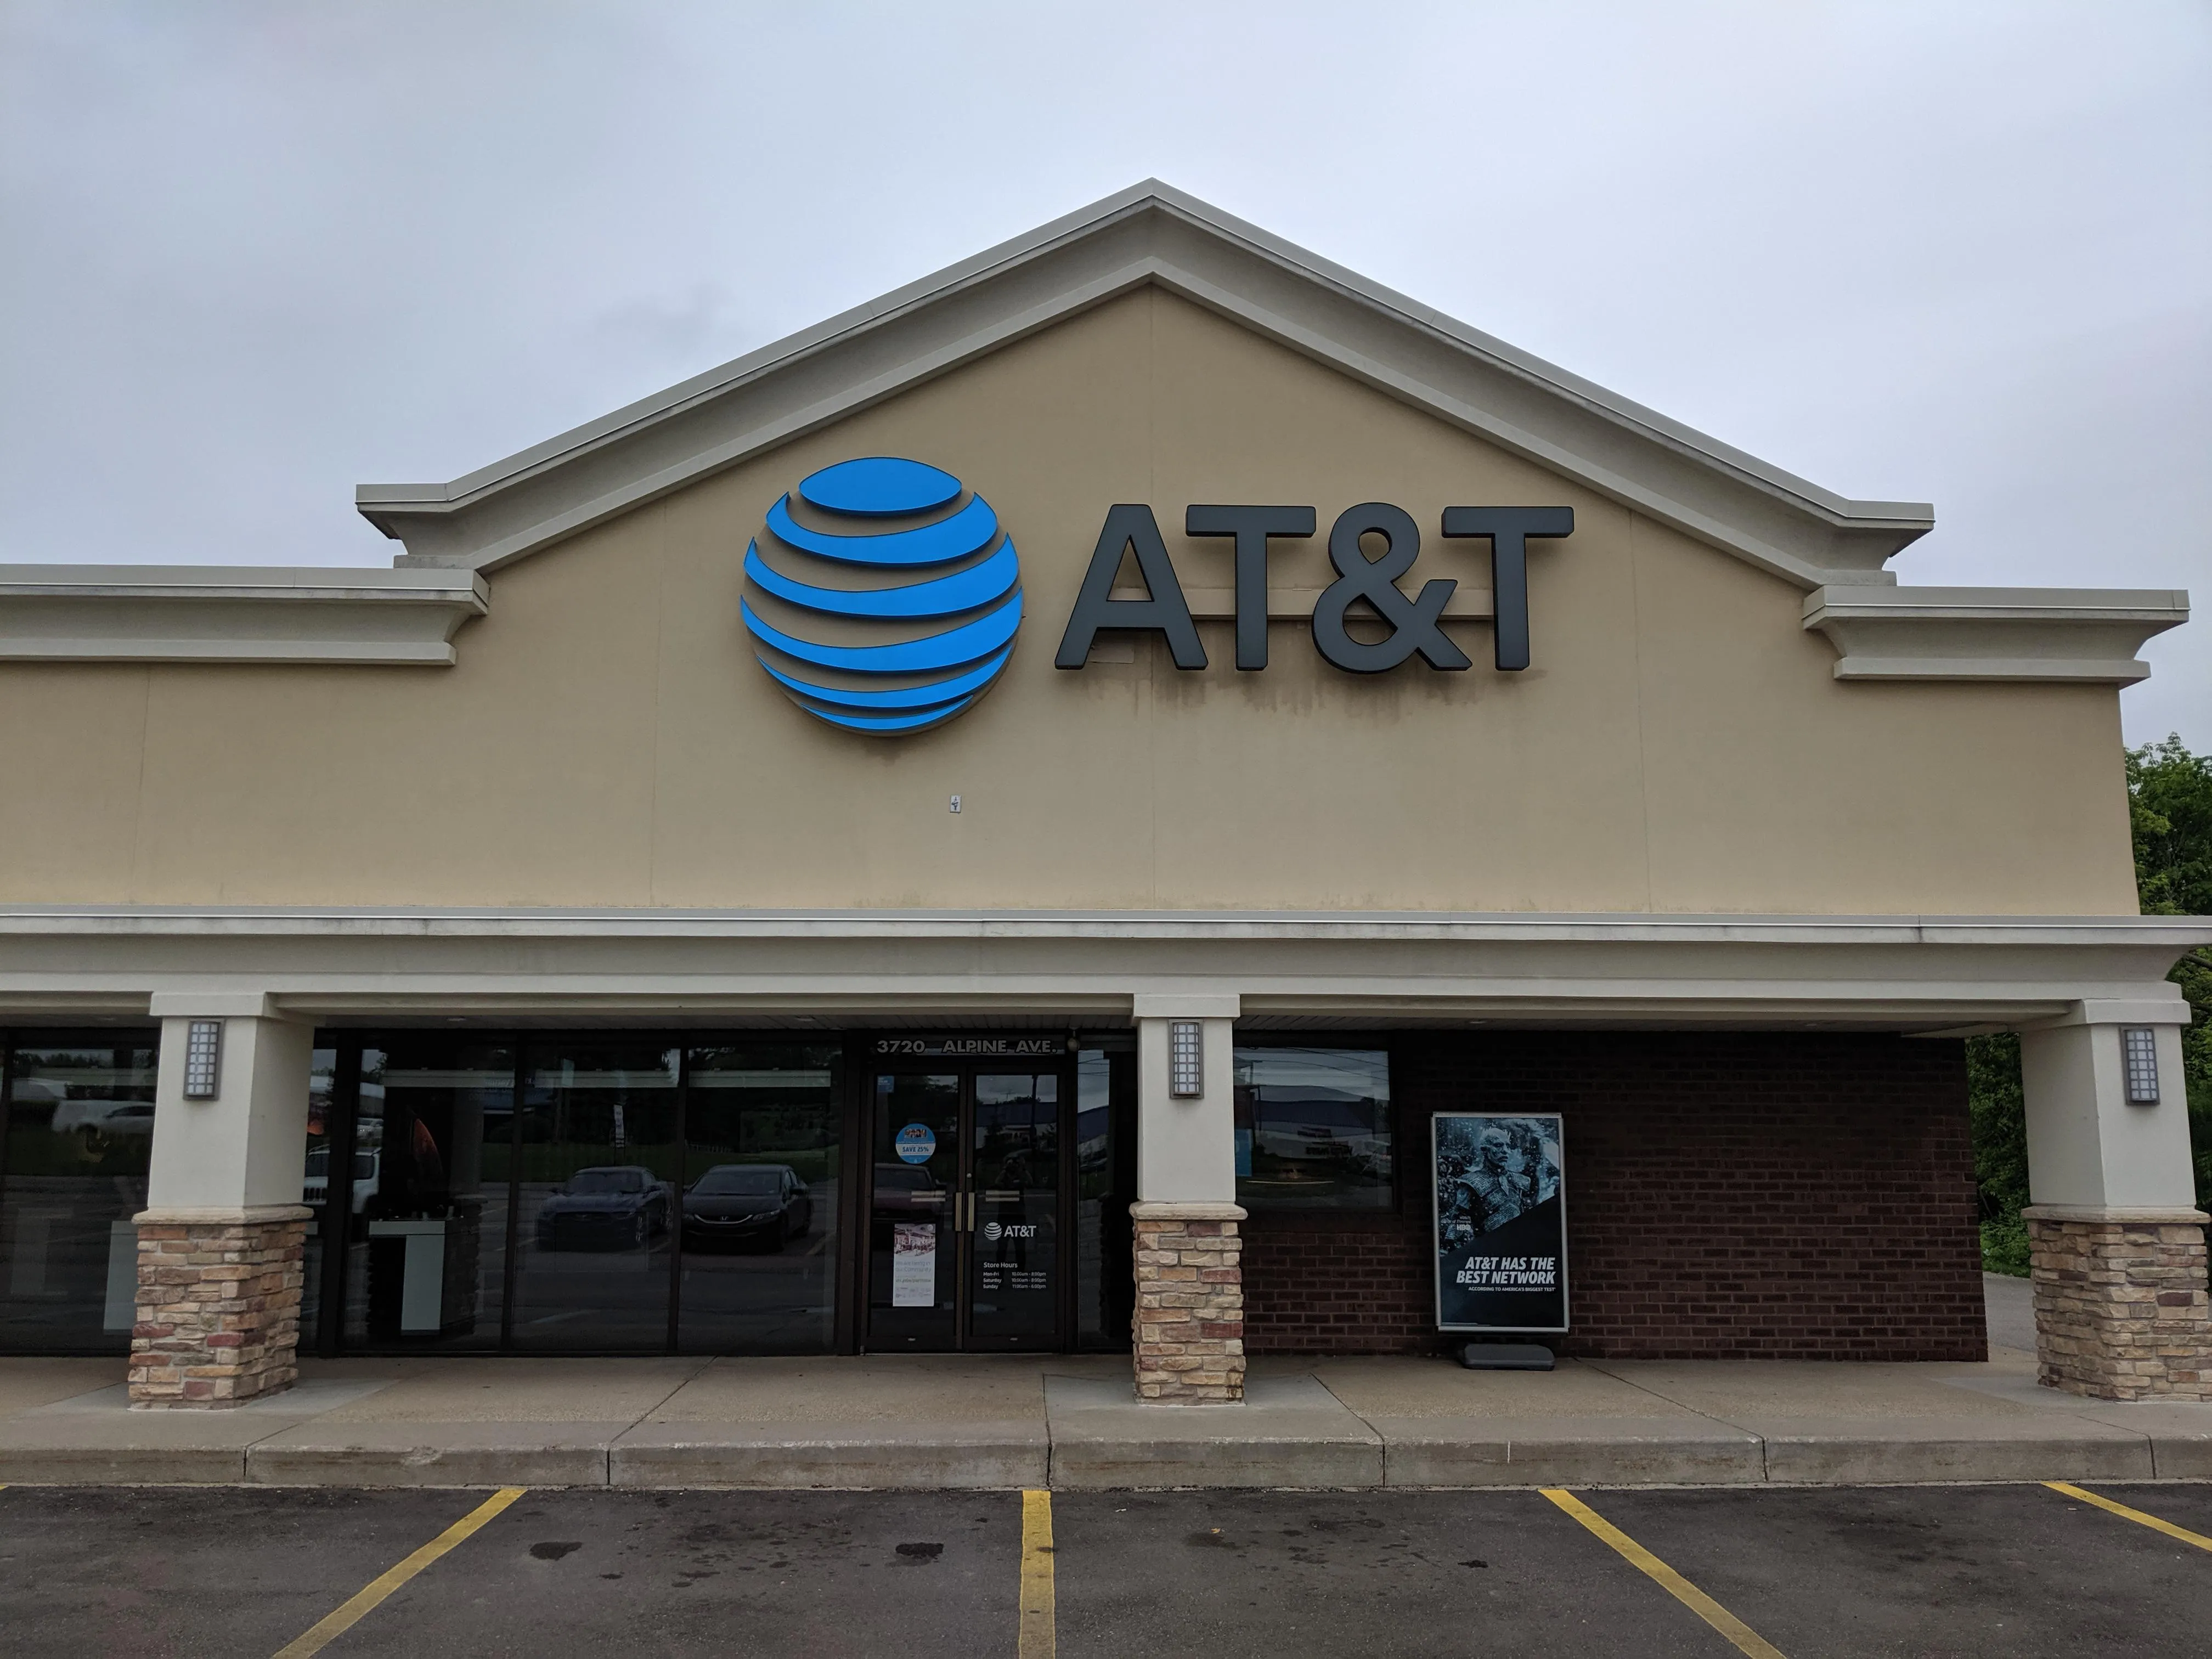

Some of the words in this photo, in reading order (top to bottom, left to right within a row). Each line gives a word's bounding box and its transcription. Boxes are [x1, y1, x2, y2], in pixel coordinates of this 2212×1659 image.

[1054, 501, 1574, 675] AT&T
[877, 1040, 926, 1053] 3720
[941, 1040, 1007, 1053] ALPINE
[1015, 1040, 1057, 1053] AVE.
[1004, 1225, 1036, 1238] AT&T
[1464, 1256, 1499, 1269] AT&T
[1500, 1257, 1527, 1270] HAS
[1530, 1257, 1555, 1270] THE
[1456, 1270, 1490, 1283] BEST
[1491, 1271, 1556, 1284] NETWORK
